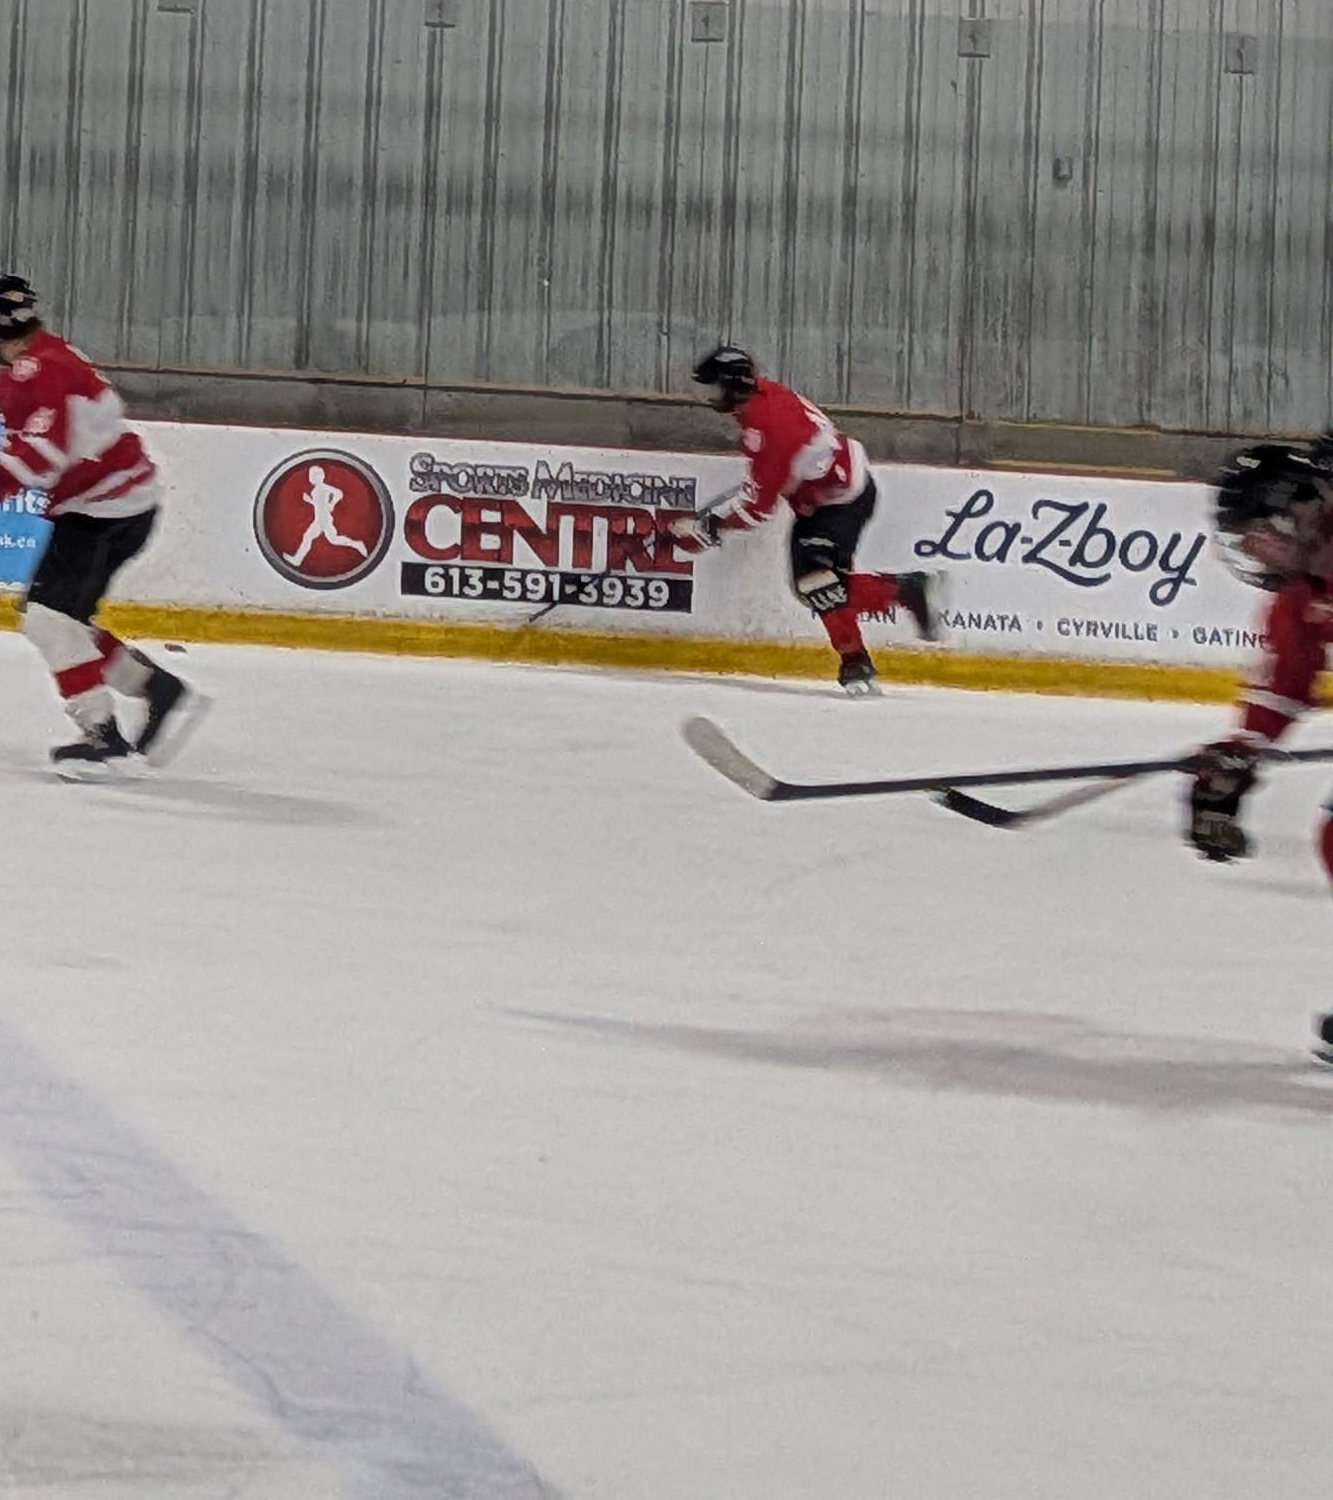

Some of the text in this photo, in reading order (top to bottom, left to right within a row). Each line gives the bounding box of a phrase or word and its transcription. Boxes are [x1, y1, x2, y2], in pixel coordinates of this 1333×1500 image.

[403, 493, 695, 576] CENTRE
[424, 566, 671, 608] 613-591-3939
[1056, 617, 1158, 643] CYRVILLE
